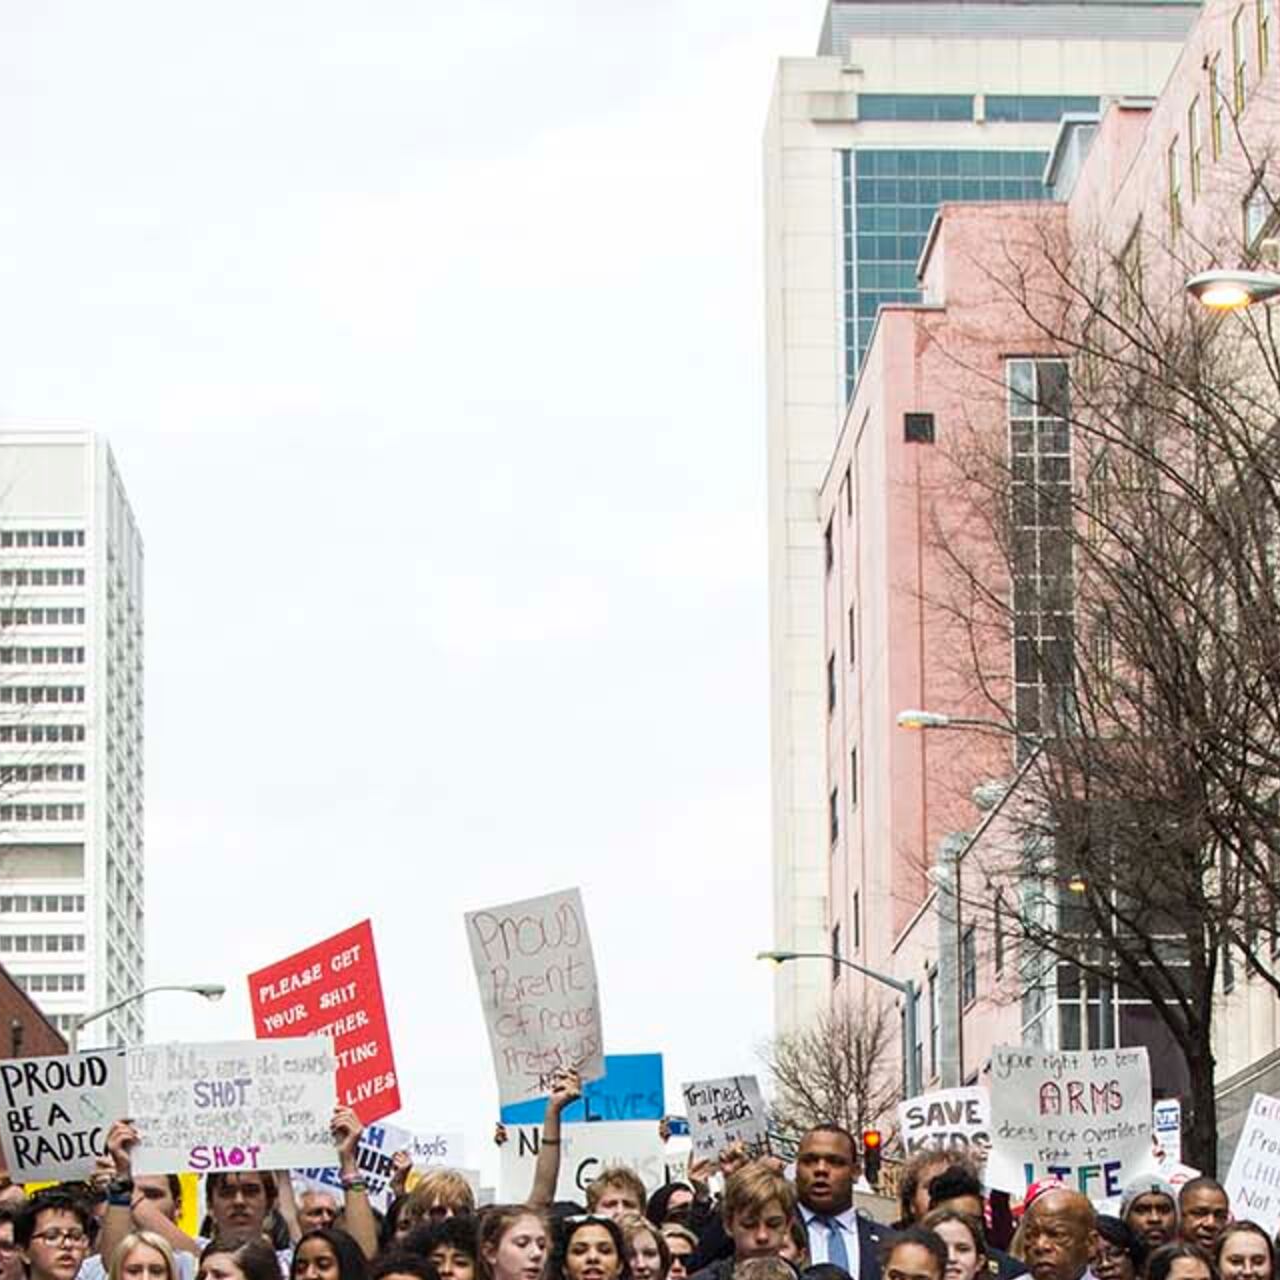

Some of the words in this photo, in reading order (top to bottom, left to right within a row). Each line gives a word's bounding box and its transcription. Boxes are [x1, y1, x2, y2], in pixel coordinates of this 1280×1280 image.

[259, 963, 322, 1004] PLEASE
[331, 944, 361, 972] GET
[263, 1004, 308, 1033] YOUR
[319, 983, 357, 1009] SHIT
[0, 1056, 108, 1107] PROUD
[1042, 1054, 1078, 1080] right
[1092, 1054, 1108, 1069] to
[193, 1078, 253, 1108] SHOT
[347, 1071, 397, 1105] LIVES
[684, 1076, 745, 1106] Trained
[1039, 1079, 1124, 1116] ARMS
[7, 1106, 40, 1133] BE
[48, 1103, 72, 1126] A
[906, 1100, 983, 1129] SAVE
[998, 1120, 1038, 1141] does
[188, 1145, 260, 1170] SHOT
